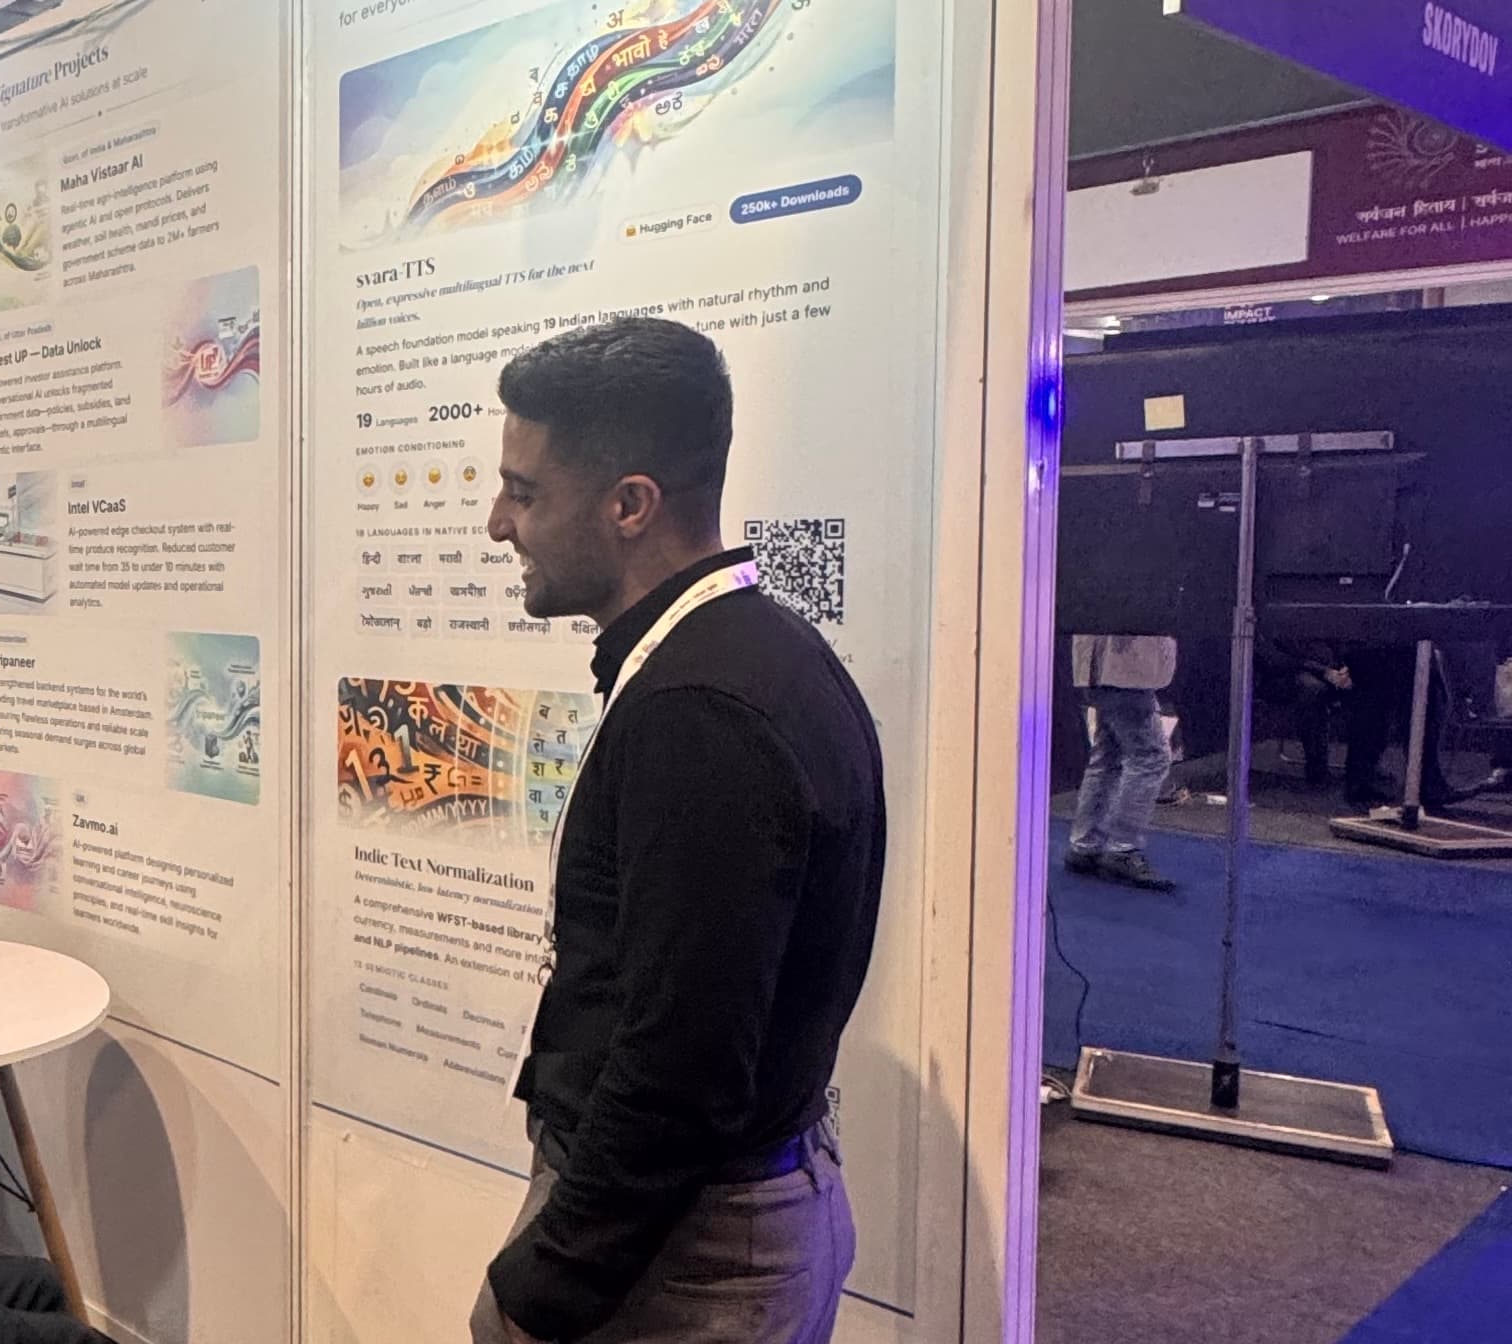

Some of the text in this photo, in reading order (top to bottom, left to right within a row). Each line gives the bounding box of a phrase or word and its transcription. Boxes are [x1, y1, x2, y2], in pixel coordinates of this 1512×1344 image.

[338, 10, 358, 28] for
[1422, 1, 1499, 77] SKORYDOV
[54, 44, 109, 81] Projects
[59, 98, 70, 111] AI
[70, 80, 110, 107] solutions
[112, 78, 122, 91] at
[123, 66, 148, 87] scale
[60, 153, 143, 192] Maha Vistaar AI
[741, 184, 850, 216] 250k+ Downloads
[640, 212, 712, 234] Hugging Face
[357, 345, 363, 356] A
[366, 340, 400, 357] speech
[402, 334, 454, 350] foundation
[457, 328, 489, 342] model
[491, 320, 540, 338] speaking
[543, 317, 556, 329] 19
[558, 312, 595, 328] Indian
[667, 294, 694, 313] with
[698, 290, 745, 308] natural
[748, 282, 798, 303] rhythm
[802, 276, 830, 293] and
[1224, 307, 1272, 320] IMPACT
[356, 378, 426, 396] hours of audio.
[356, 403, 507, 428] 19 Languages 2000+ Hou
[356, 440, 465, 456] EMOTION CONDITIONING
[68, 499, 127, 515] Intel VCaaS
[111, 525, 129, 538] edge
[131, 522, 166, 535] checkout
[168, 523, 195, 536] system
[198, 522, 215, 534] with
[216, 522, 235, 533] real-
[72, 814, 119, 836] Zavmo.ai
[354, 846, 535, 892] Indic Text Normalization
